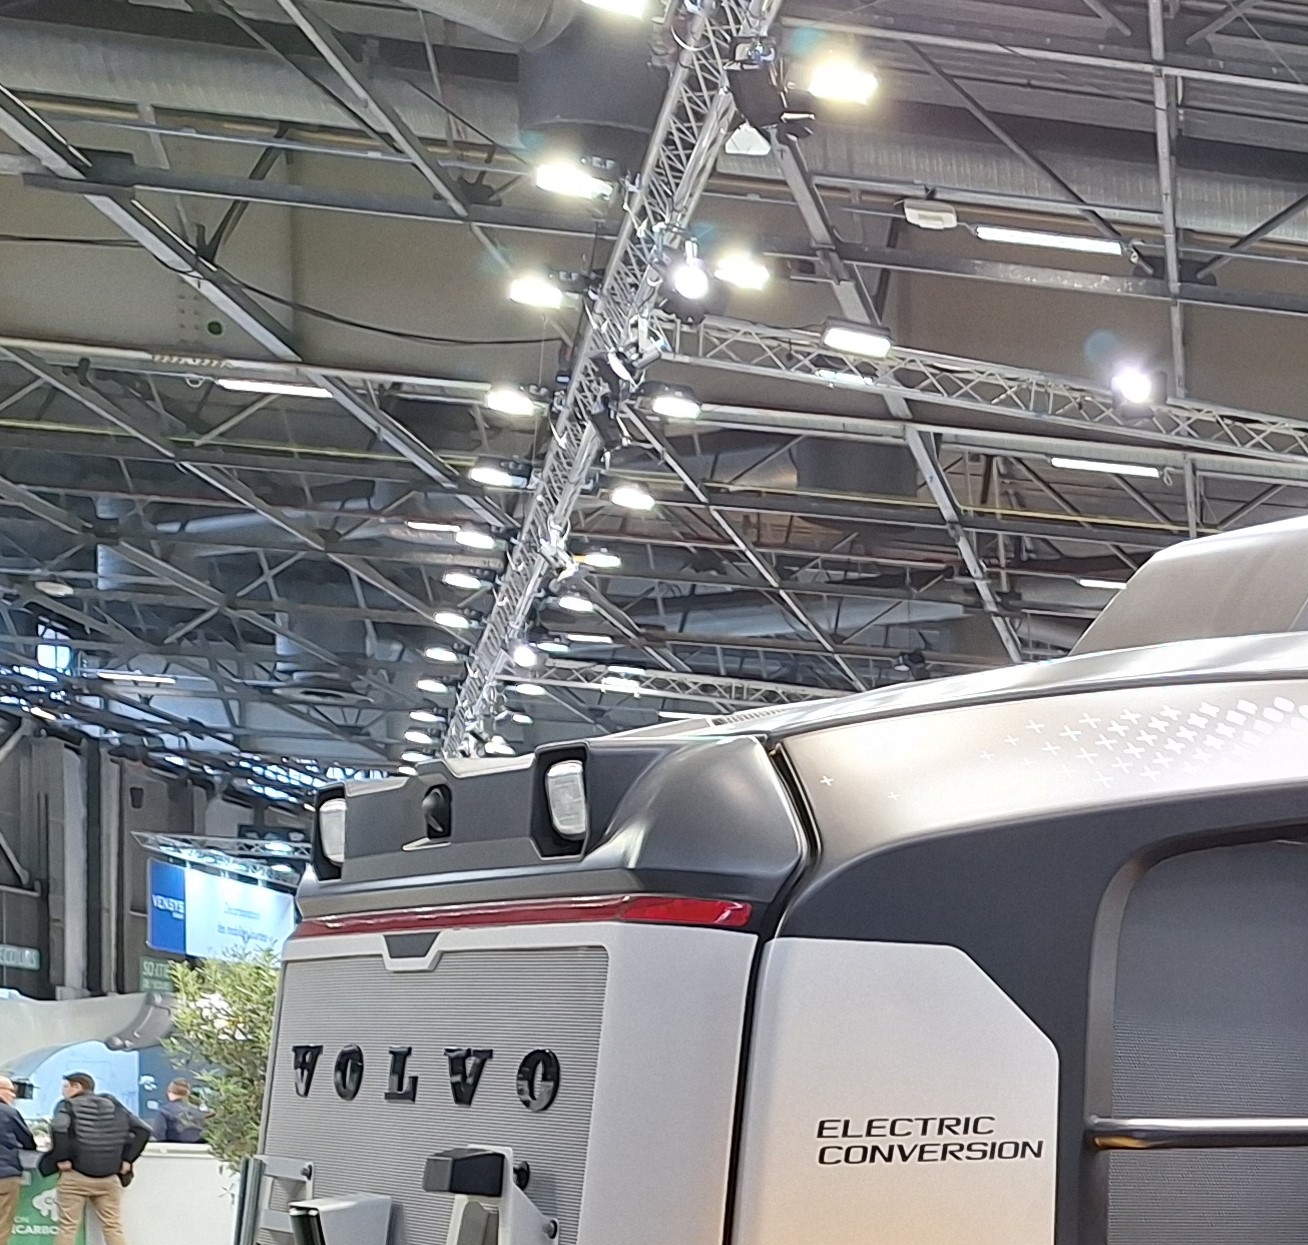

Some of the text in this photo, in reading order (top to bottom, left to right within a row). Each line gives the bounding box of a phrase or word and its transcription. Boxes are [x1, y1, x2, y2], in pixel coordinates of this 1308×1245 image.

[292, 1044, 560, 1112] VOLVO
[816, 1116, 996, 1138] ELECTRIC
[818, 1140, 1044, 1164] CONVERSION
